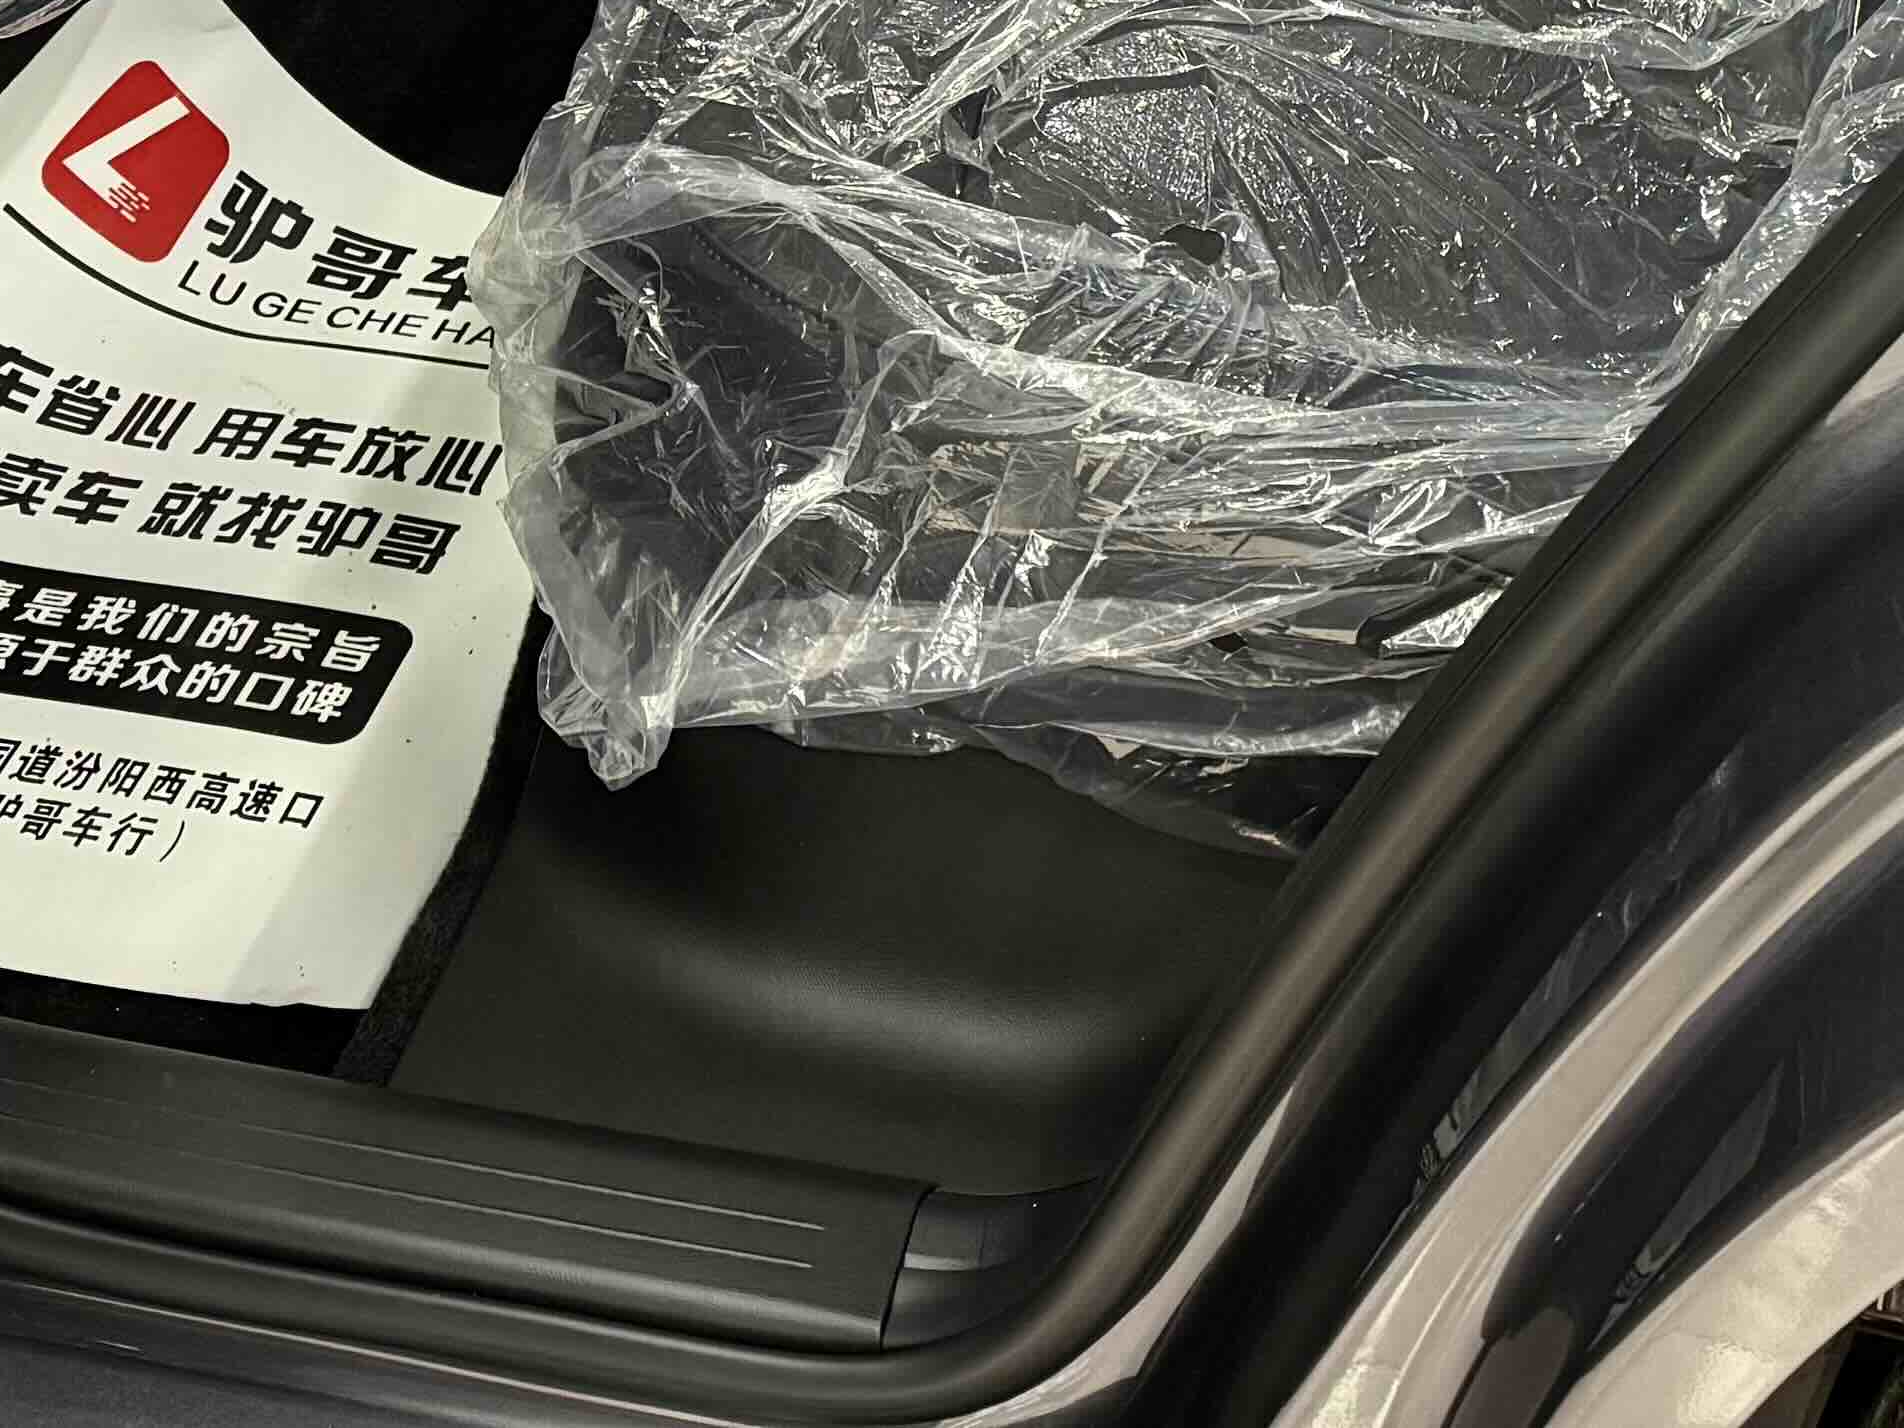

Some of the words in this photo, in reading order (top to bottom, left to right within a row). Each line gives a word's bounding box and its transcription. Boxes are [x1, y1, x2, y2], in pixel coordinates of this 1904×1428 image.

[193, 407, 503, 496] 用车放心
[136, 482, 462, 575] 就找驴哥
